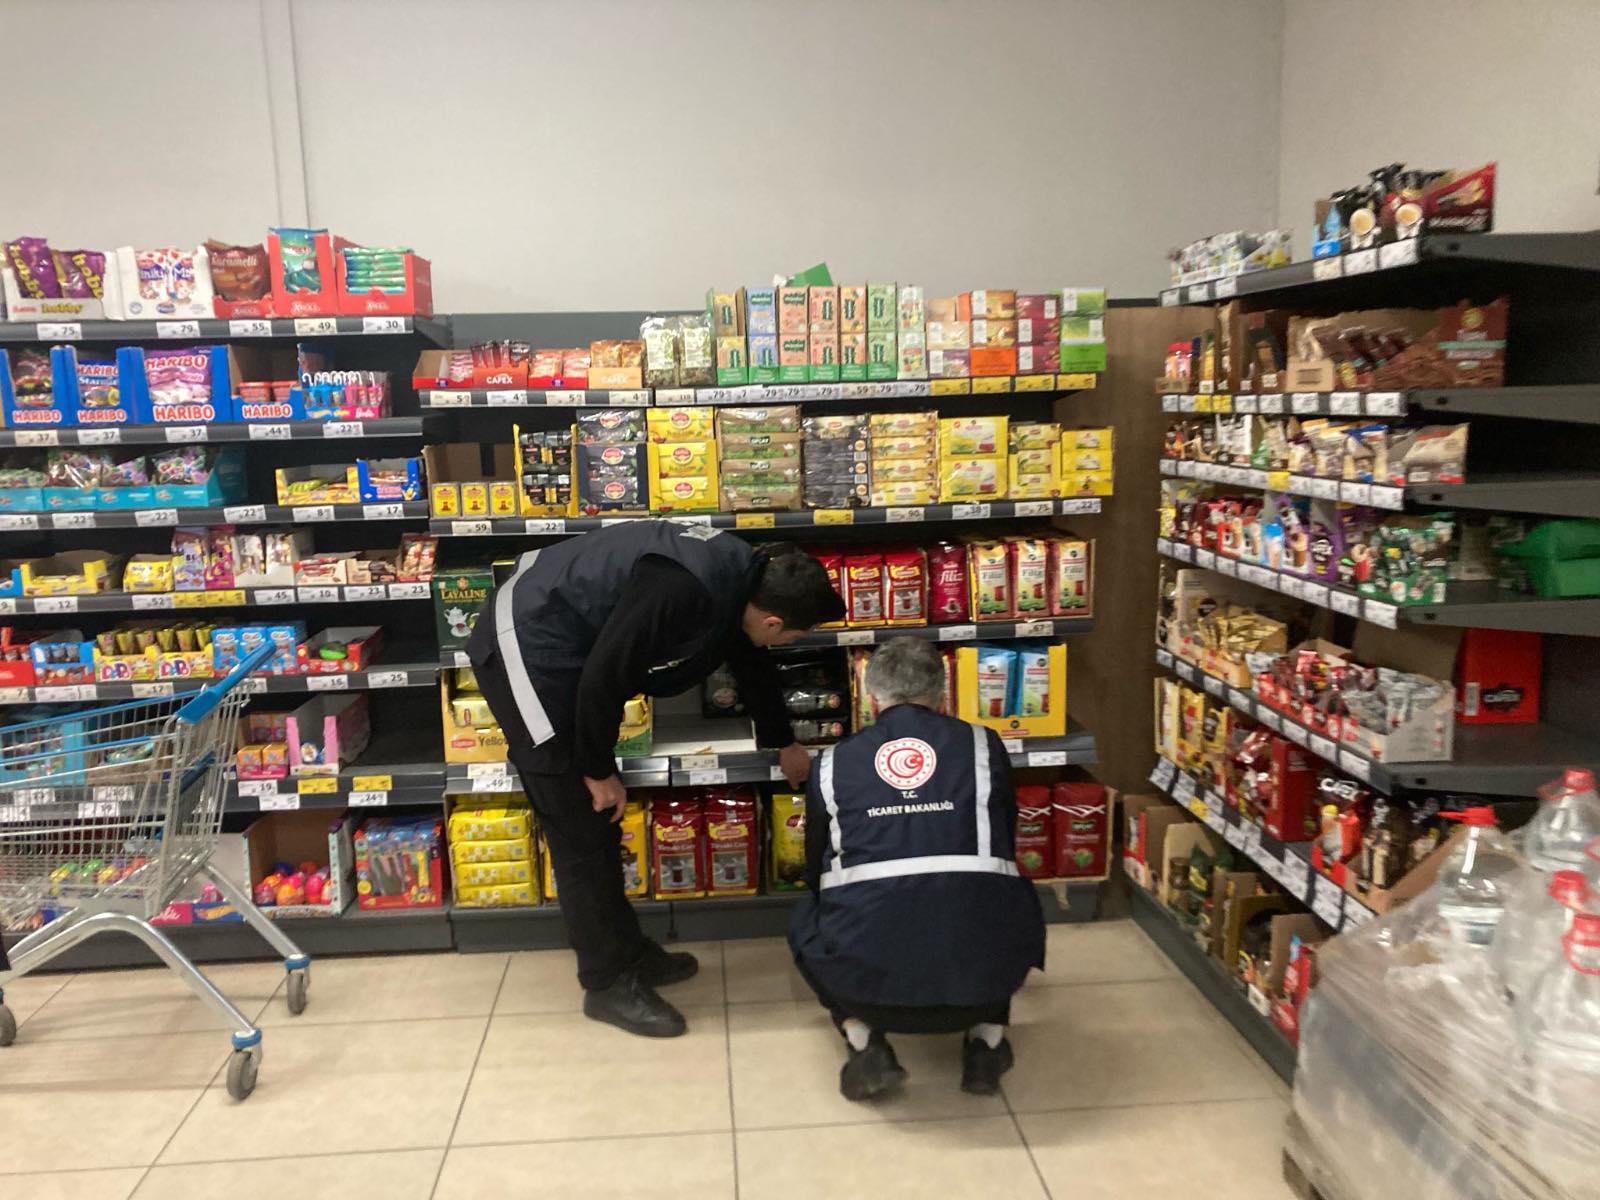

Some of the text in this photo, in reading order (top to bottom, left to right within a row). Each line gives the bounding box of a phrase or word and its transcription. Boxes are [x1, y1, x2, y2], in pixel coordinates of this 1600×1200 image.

[253, 322, 265, 330] 55
[318, 321, 331, 330] 49
[386, 320, 399, 329] 30
[62, 327, 75, 336] 75
[181, 325, 193, 333] 79
[146, 355, 207, 371] HARIBO
[788, 388, 800, 396] 79
[821, 388, 833, 396] 79
[857, 386, 869, 394] 59
[880, 385, 892, 393] 79
[914, 384, 926, 392] 79
[713, 391, 725, 399] 79
[765, 389, 777, 397] 79
[155, 406, 214, 421] HARIBO
[243, 405, 291, 418] HARIBO
[13, 410, 61, 422] HARIBO
[78, 410, 127, 422] HARIBO
[269, 427, 281, 435] 44
[340, 425, 352, 433] 22
[37, 433, 50, 442] 37
[103, 432, 115, 440] 37
[190, 430, 202, 438] 37
[387, 507, 399, 515] 17
[74, 516, 86, 524] 22
[155, 512, 168, 520] 22
[475, 524, 487, 532] 59
[546, 522, 557, 531] 22
[319, 590, 332, 598] 10
[368, 587, 380, 595] 23
[412, 586, 424, 594] 23
[275, 592, 287, 600] 45
[58, 601, 71, 609] 12
[152, 598, 165, 606] 52
[492, 779, 504, 787] 49
[260, 783, 272, 792] 19
[902, 790, 918, 799] T.C.
[867, 800, 954, 818] TİCARET BAKANLIĞI
